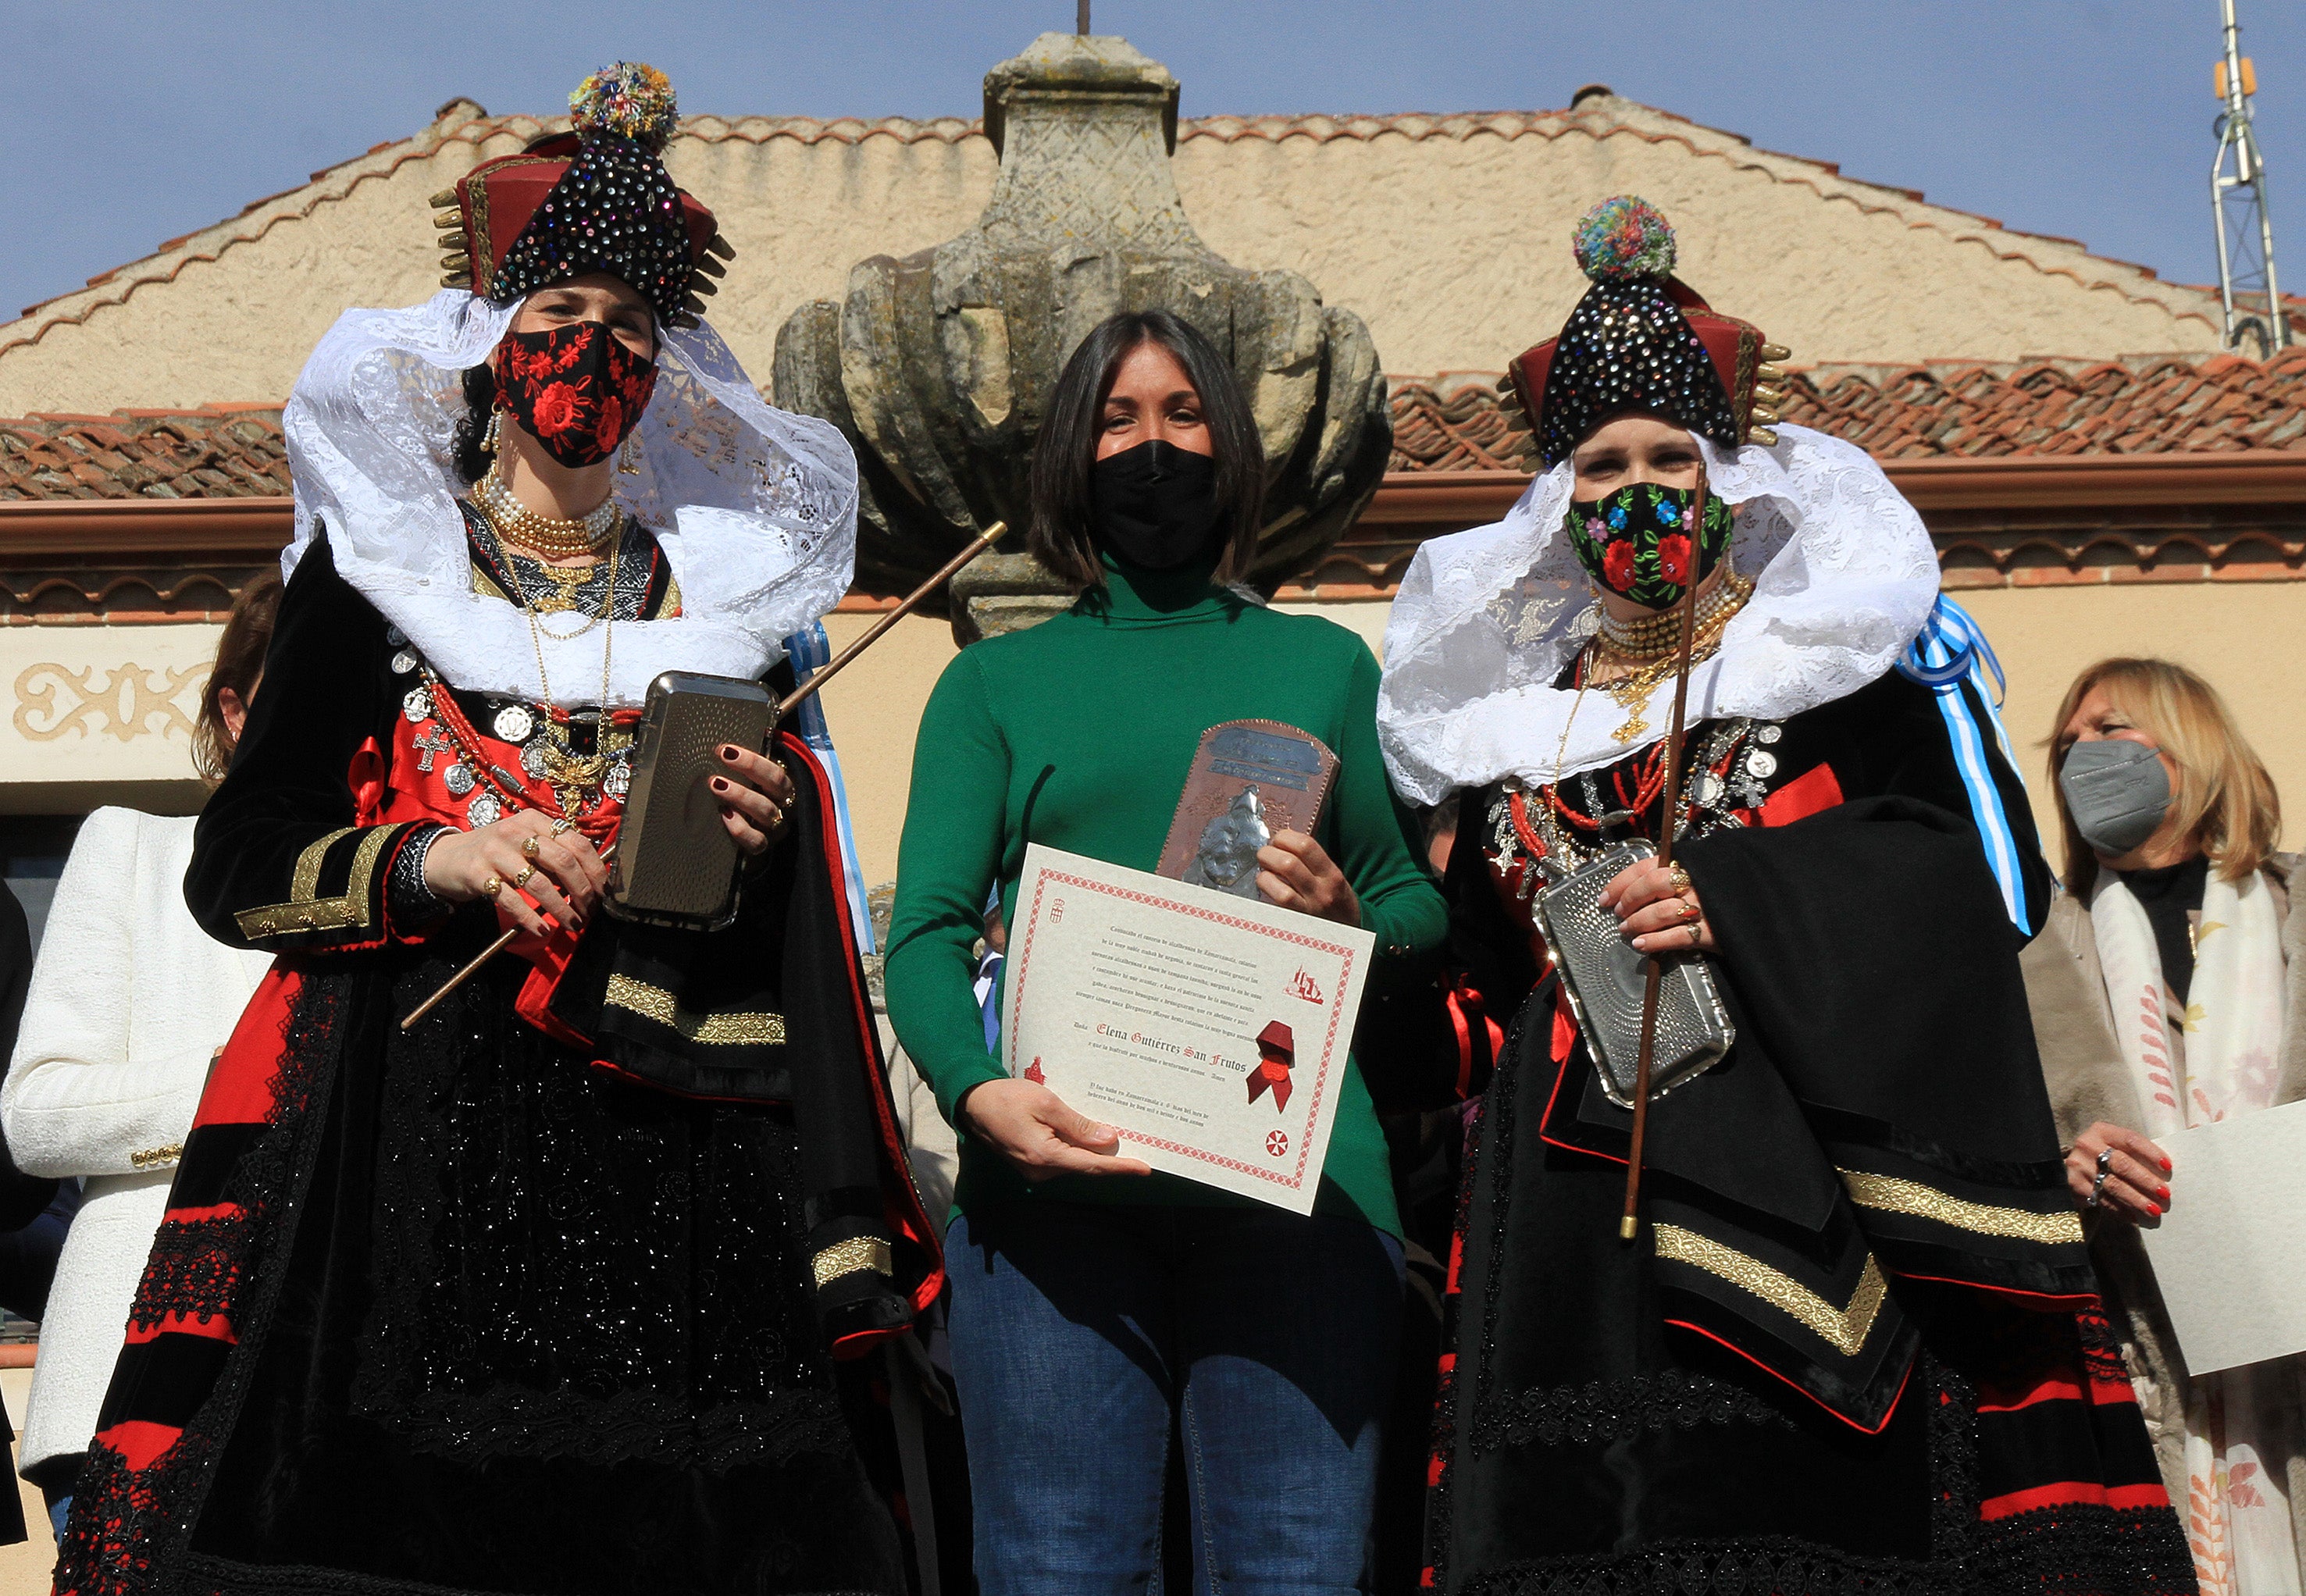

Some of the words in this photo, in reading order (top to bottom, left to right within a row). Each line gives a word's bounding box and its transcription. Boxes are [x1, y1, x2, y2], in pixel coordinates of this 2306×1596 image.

[1096, 1024, 1128, 1040] Elena
[1131, 1033, 1181, 1055] Gutiérrez
[1183, 1047, 1206, 1061] San
[1209, 1055, 1247, 1072] Frutos
